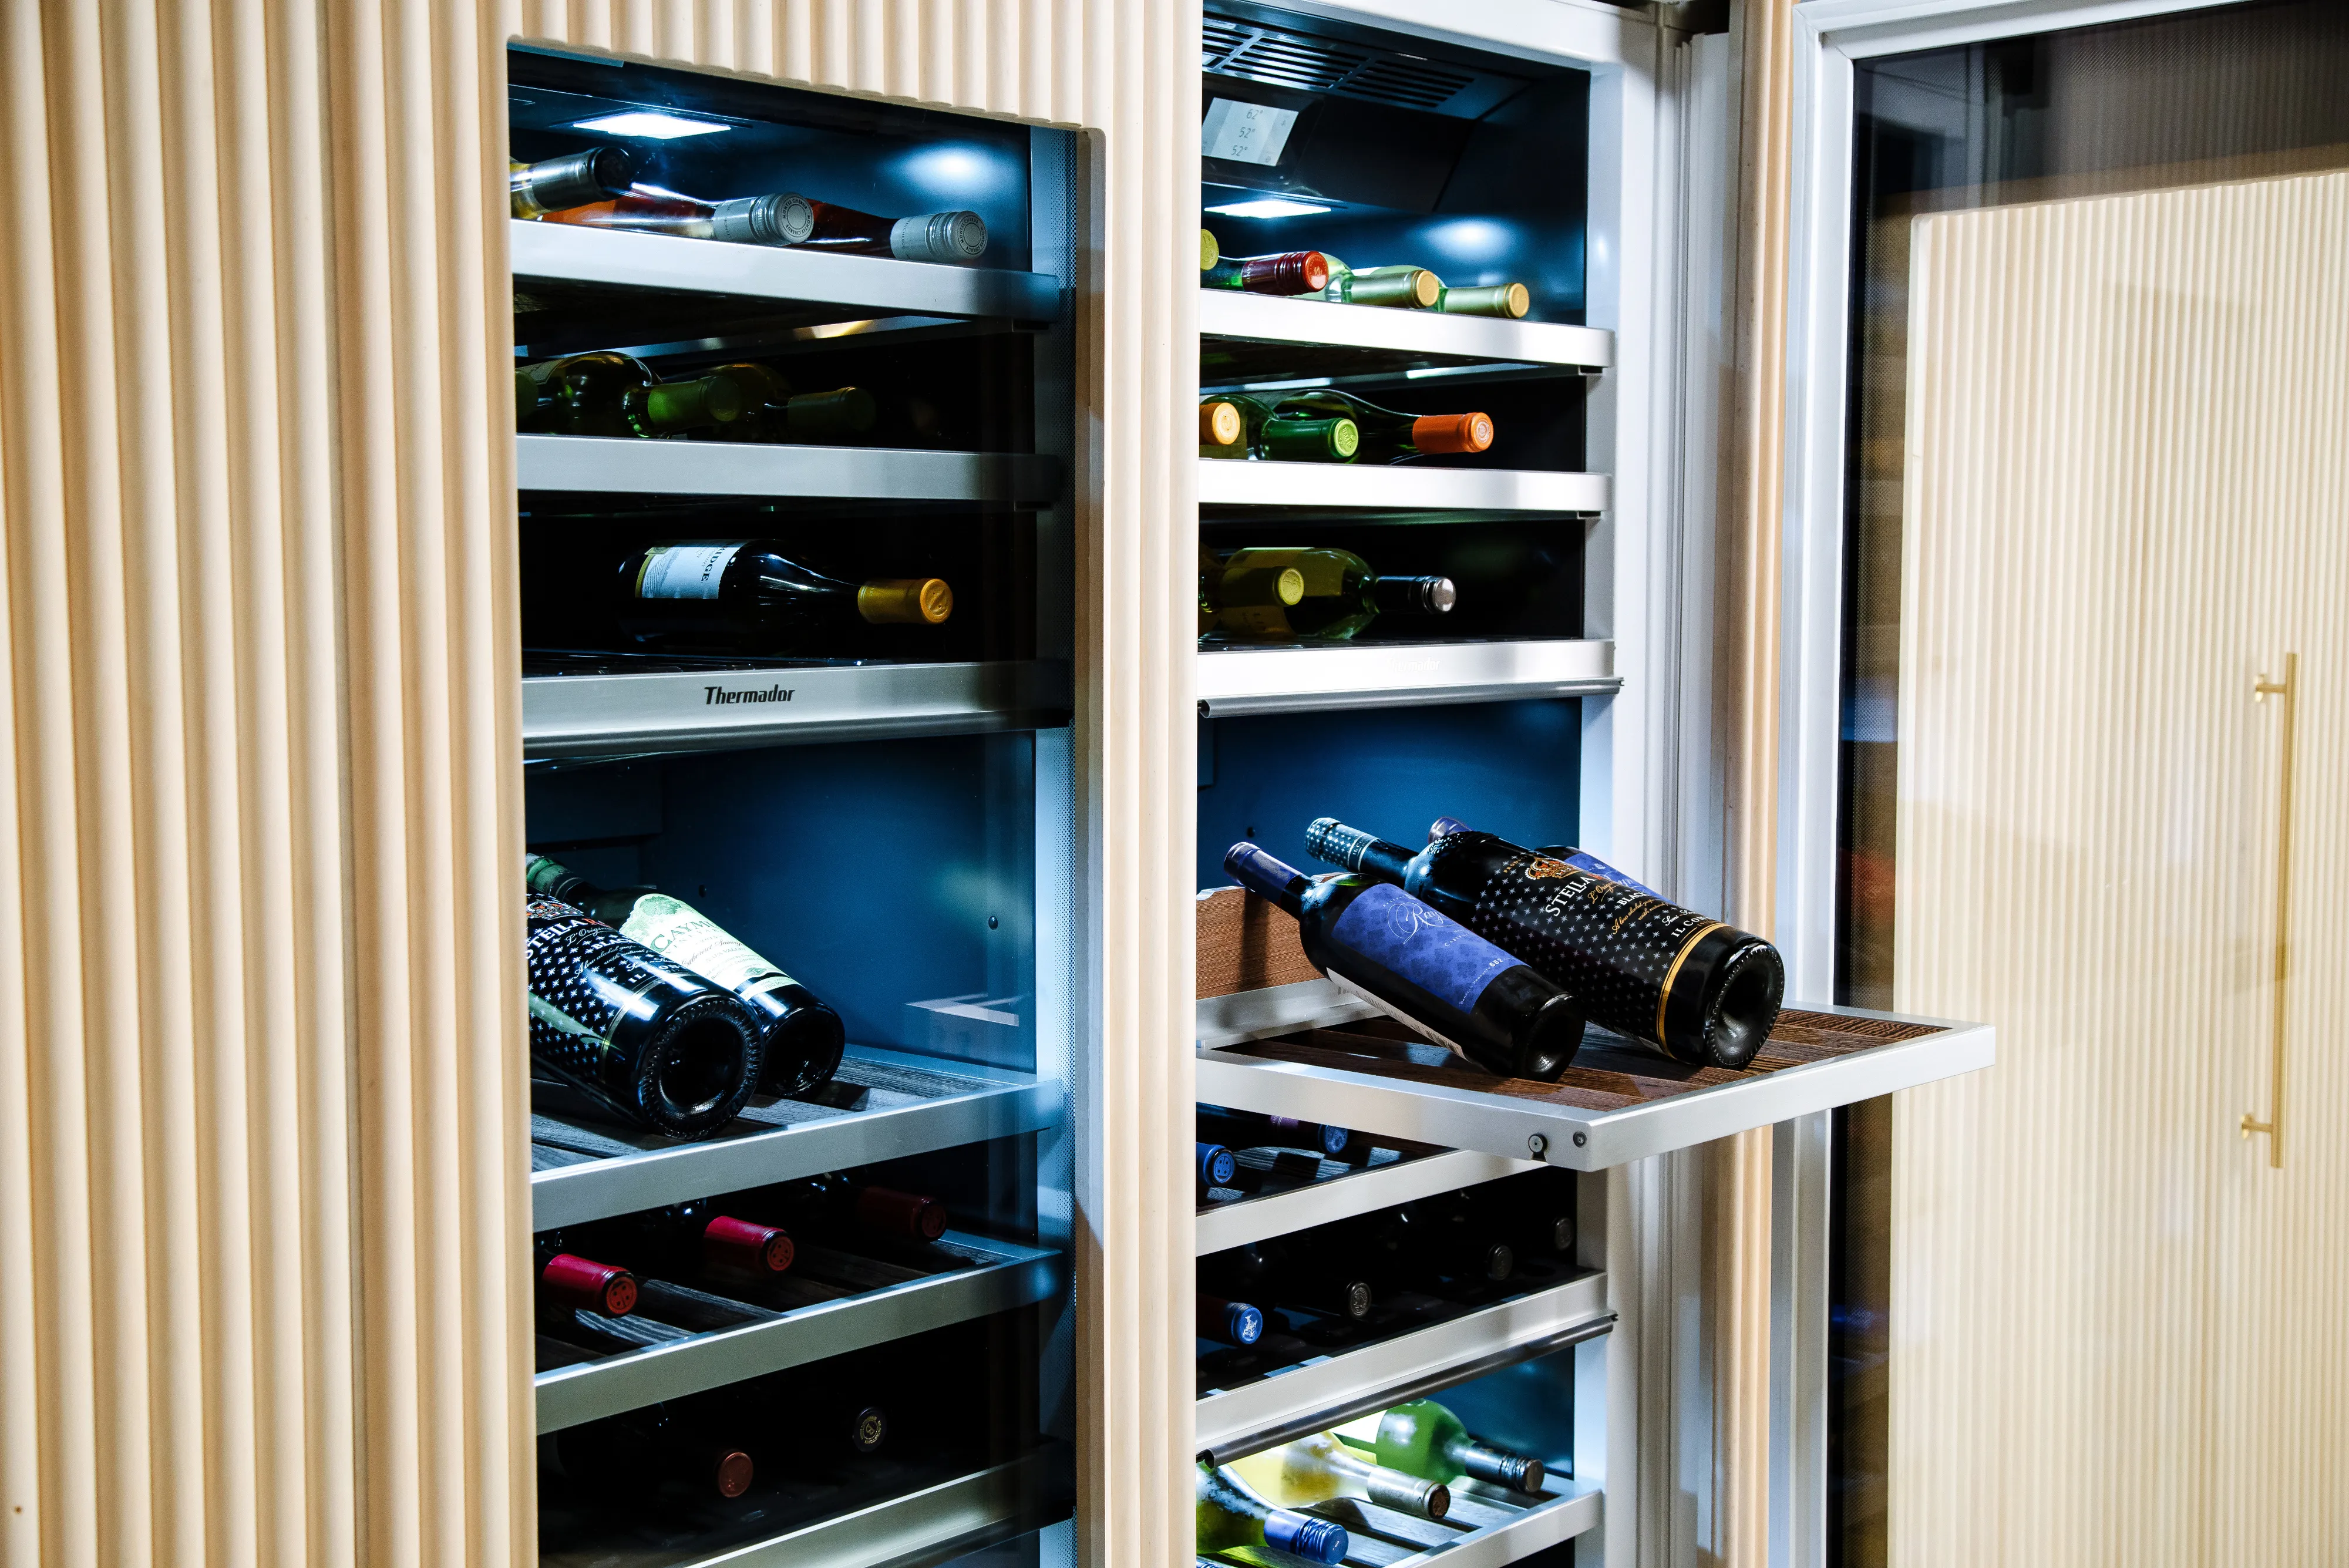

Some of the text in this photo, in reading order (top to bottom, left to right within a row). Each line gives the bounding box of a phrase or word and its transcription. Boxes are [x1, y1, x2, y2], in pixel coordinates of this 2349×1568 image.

[704, 684, 796, 705] Thermador
[1545, 876, 1597, 917] STELLA
[1617, 891, 1649, 906] BLACK
[1671, 926, 1686, 938] IL
[1489, 958, 1503, 967] 682
